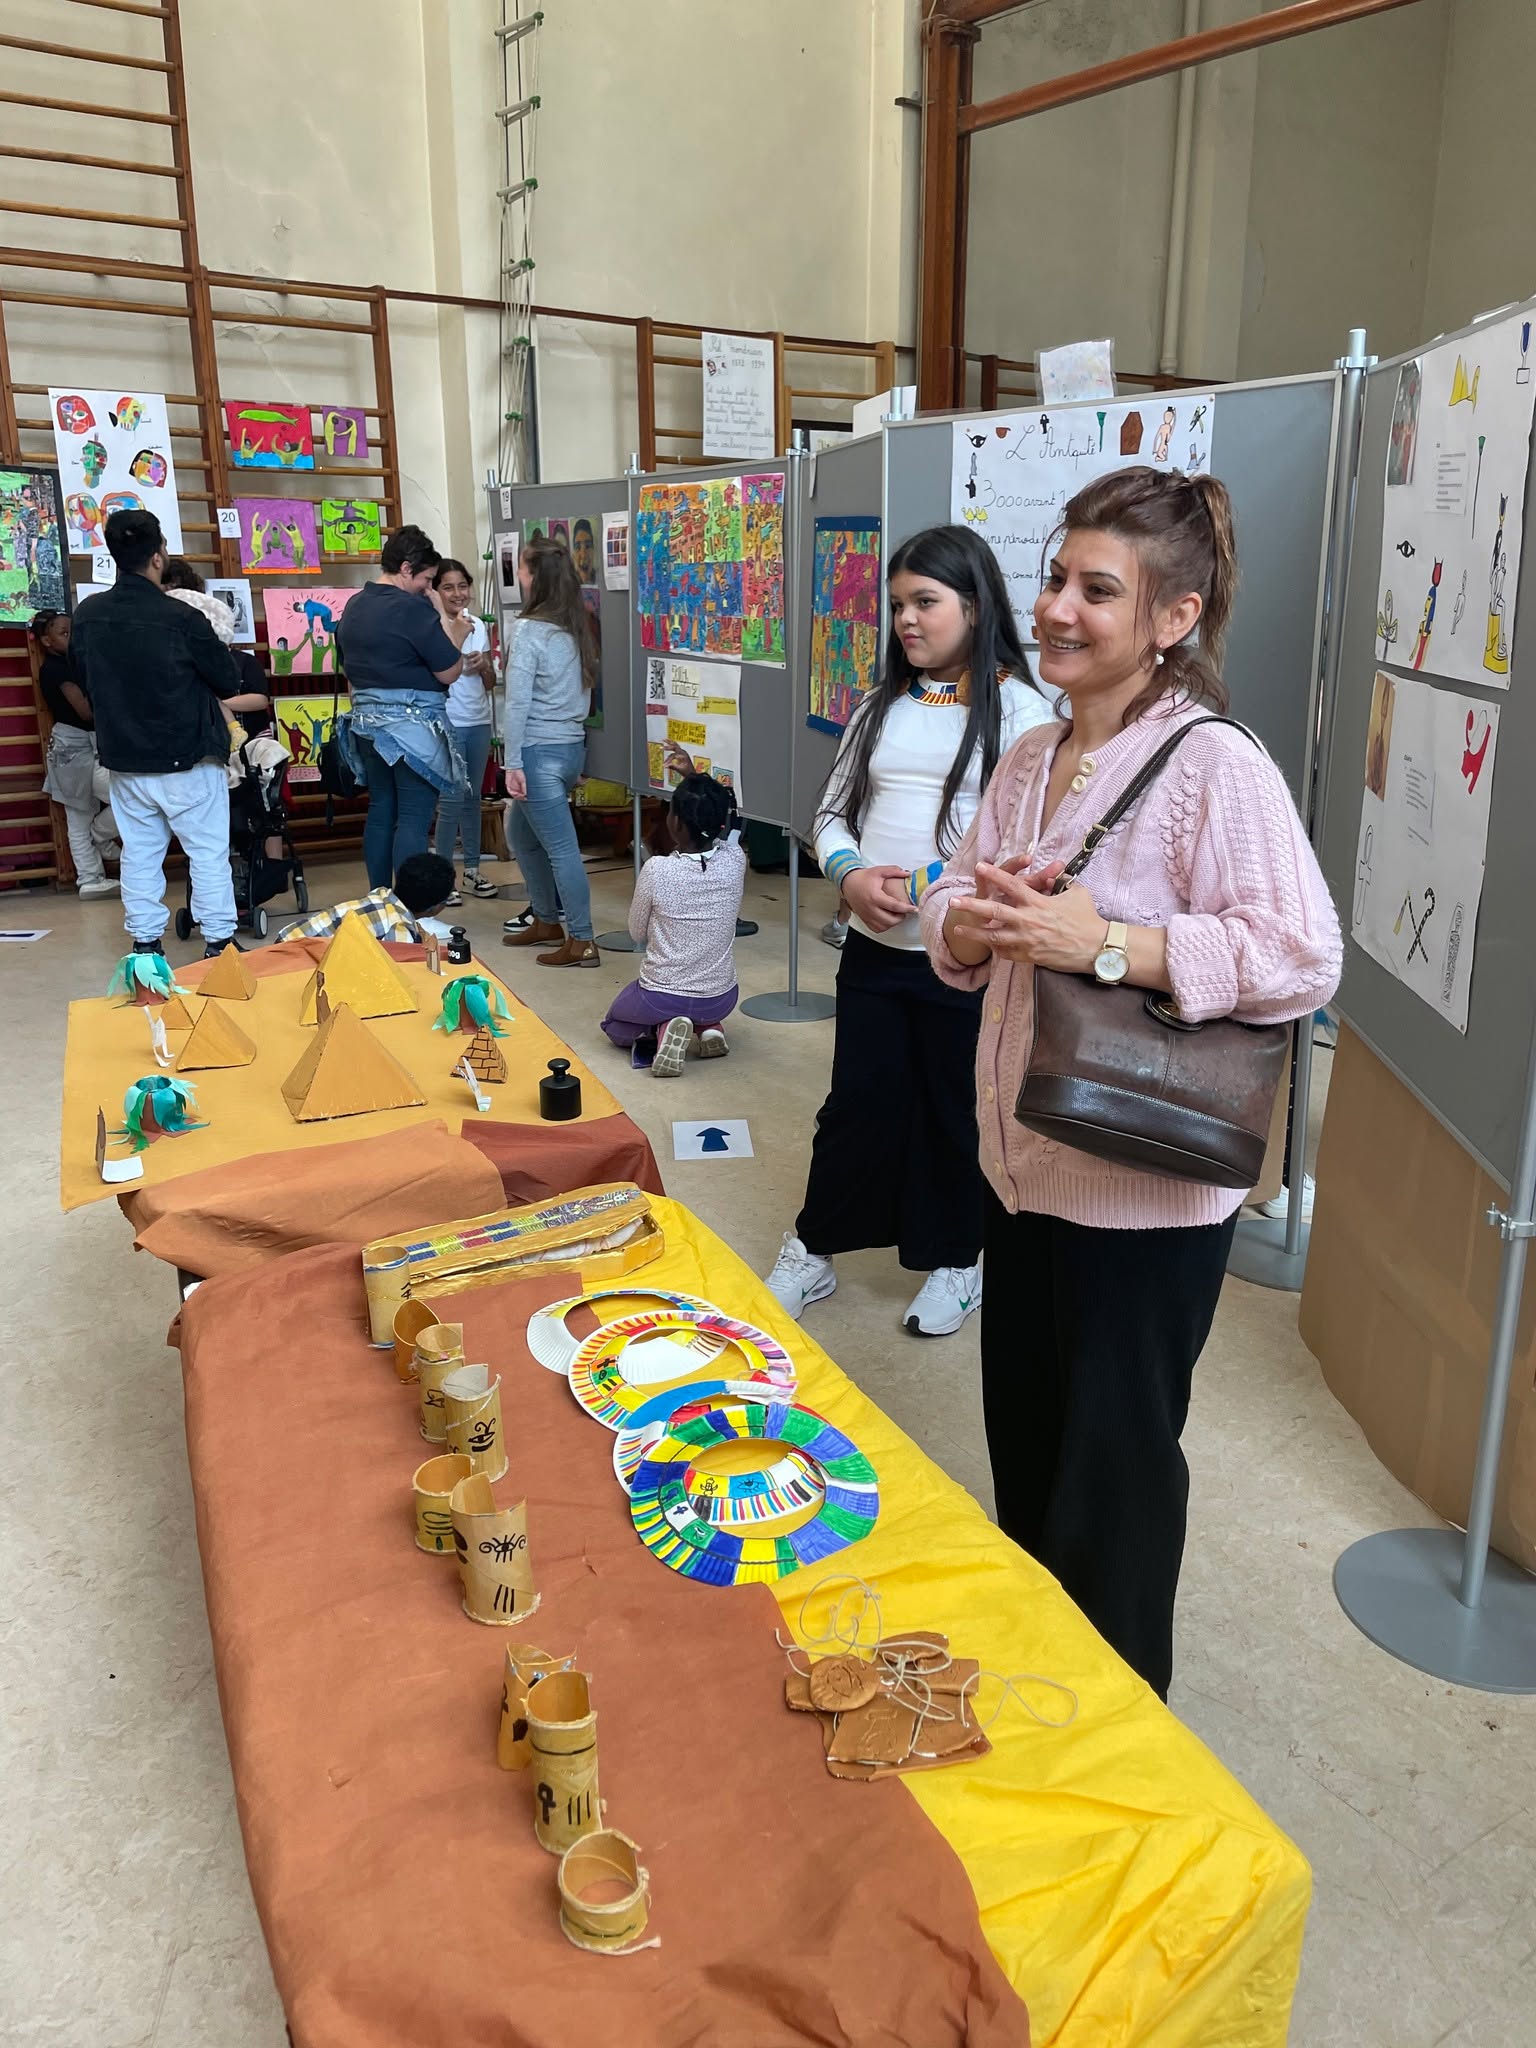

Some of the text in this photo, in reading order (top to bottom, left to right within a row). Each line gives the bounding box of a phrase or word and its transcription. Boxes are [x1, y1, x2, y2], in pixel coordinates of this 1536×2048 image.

[983, 479, 1022, 508] 3000
[221, 511, 236, 523] 20
[96, 556, 111, 569] 21
